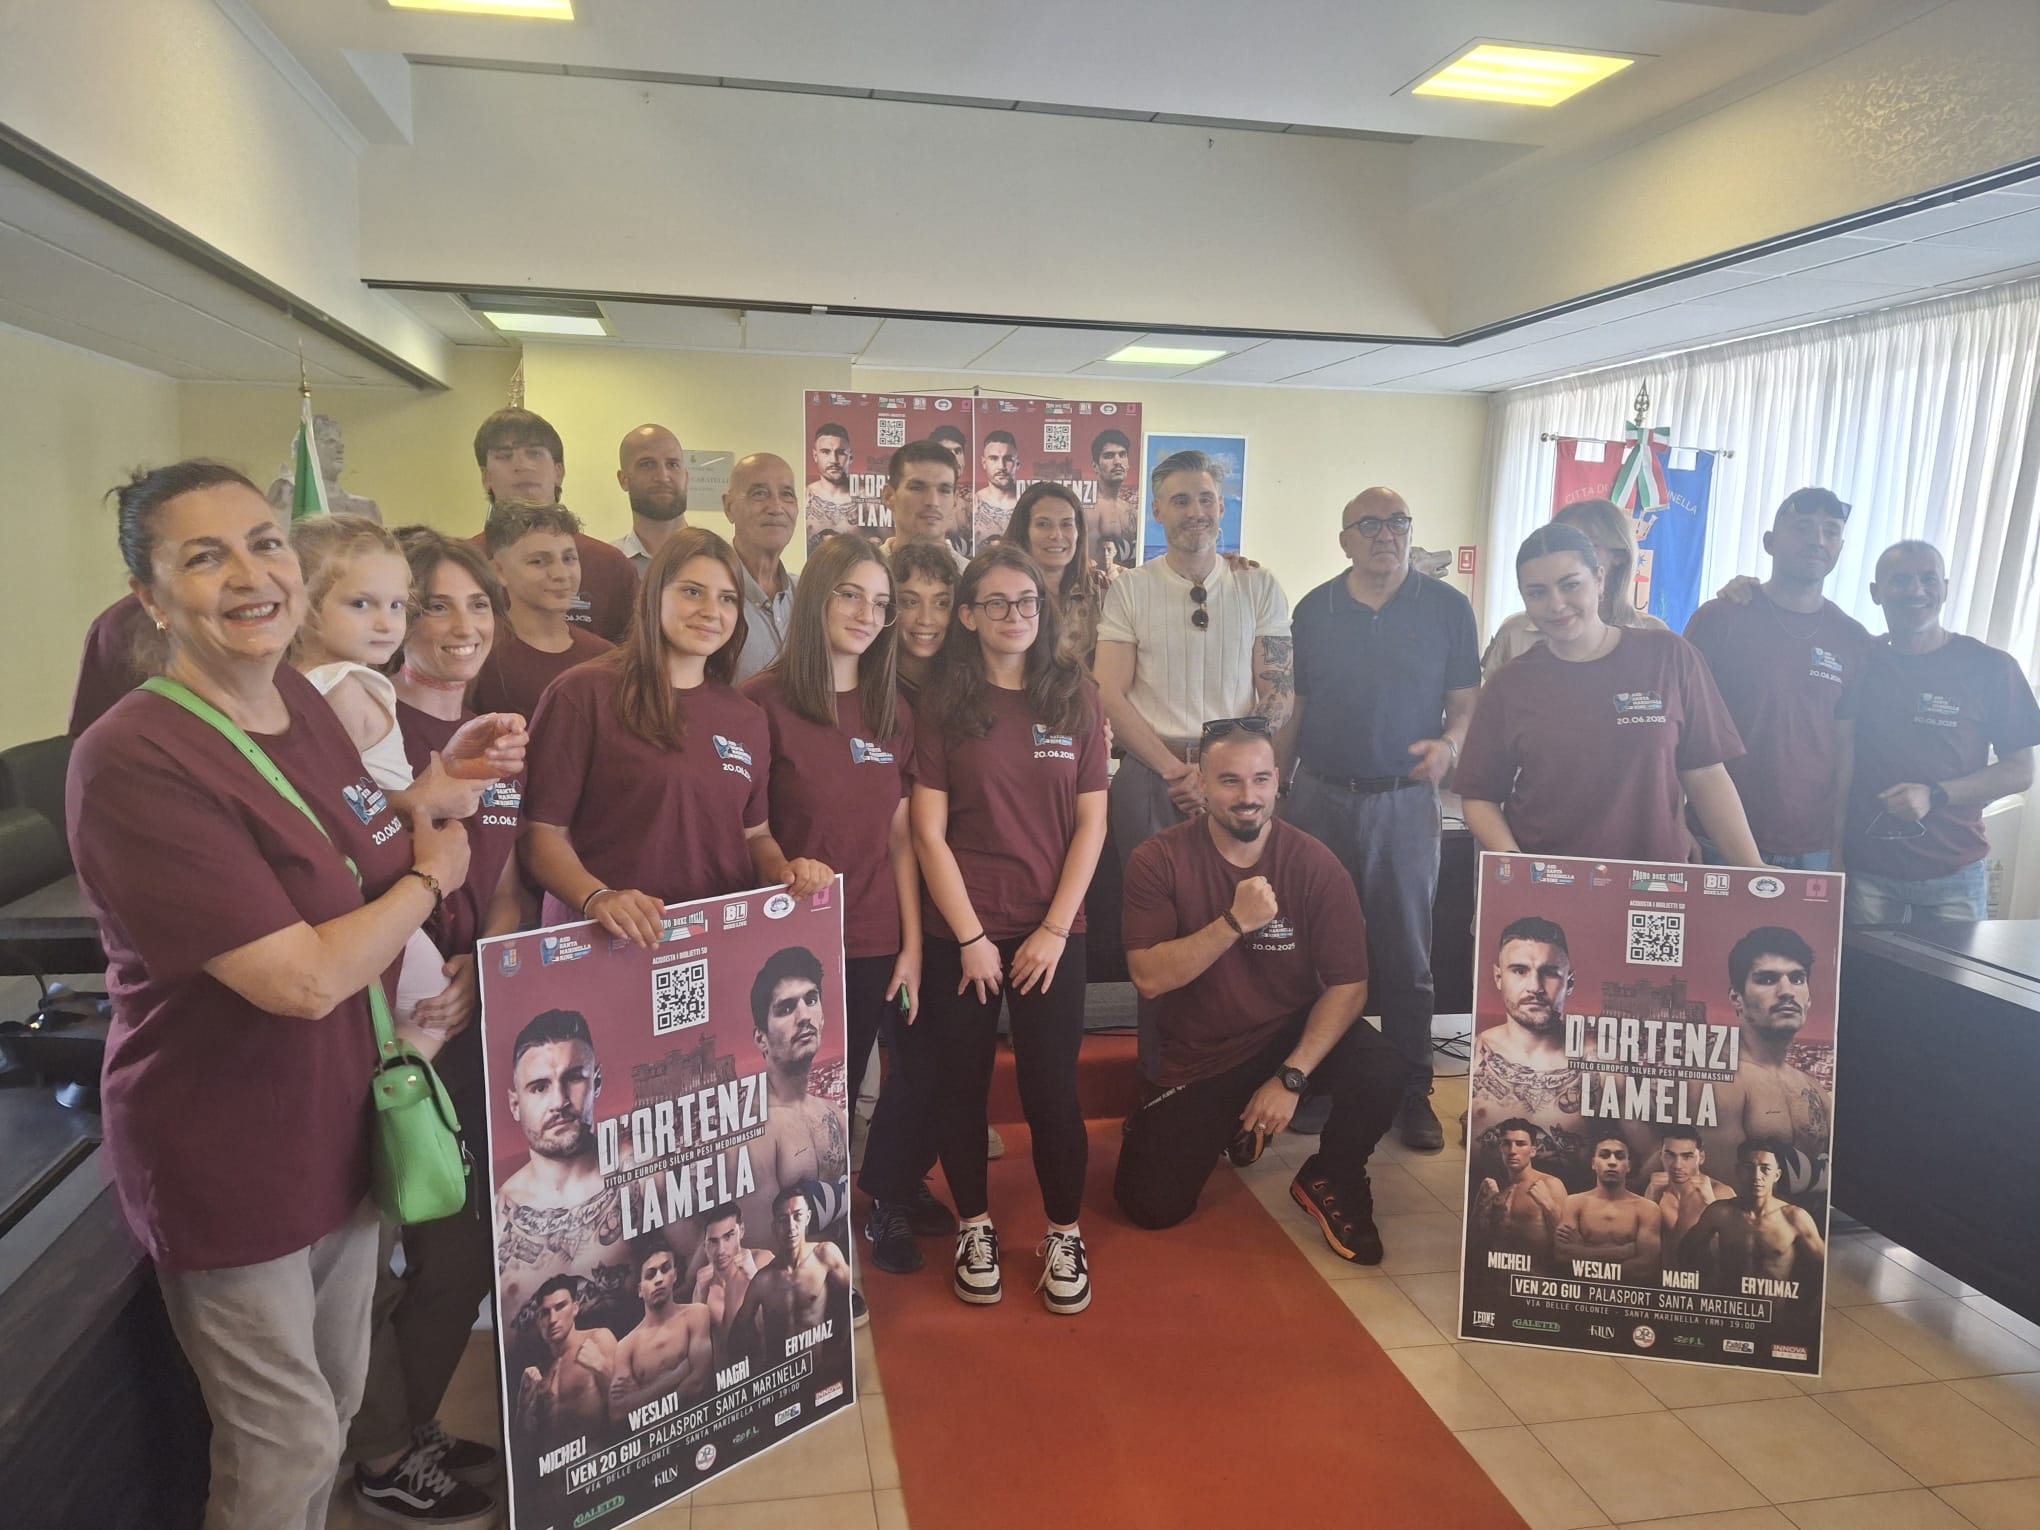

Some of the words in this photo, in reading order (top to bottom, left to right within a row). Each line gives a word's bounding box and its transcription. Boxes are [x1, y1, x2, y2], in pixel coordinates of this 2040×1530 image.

[1616, 715, 1666, 725] 20.06.2025
[725, 902, 747, 922] BL
[1564, 1013, 1740, 1072] D'ORTENZI
[1569, 1061, 1595, 1072] TITOLO
[1596, 1063, 1630, 1074] EUROPEO
[1631, 1066, 1657, 1076] SILVER
[1659, 1068, 1676, 1078] PESI
[1678, 1070, 1735, 1082] MEDIOMASSIMI
[1580, 1072, 1718, 1128] LAMELA
[597, 1071, 769, 1177] D'ORTENZI
[605, 1172, 633, 1189] TITOLO
[634, 1159, 668, 1180] EUROPEO
[669, 1150, 695, 1167] SILVER
[696, 1144, 714, 1158] PESI
[715, 1126, 766, 1153] MEDIOMASSIMI
[620, 1144, 756, 1242] LAMELA
[1487, 1251, 1531, 1273] MICHELI
[1572, 1259, 1622, 1282] WESLATI
[1515, 1278, 1539, 1296] VEN
[1541, 1281, 1558, 1298] 20
[1561, 1283, 1582, 1300] GIU
[1588, 1286, 1652, 1307] PALASPORT
[1658, 1293, 1695, 1312] SANTA
[1699, 1298, 1765, 1319] MARINELLA
[1741, 1276, 1800, 1300] ERYILMAZ
[1473, 1310, 1496, 1327] LEONE
[1525, 1299, 1542, 1308] VIA
[1545, 1301, 1571, 1312] DELLE
[1574, 1303, 1609, 1316] COLONIE
[1624, 1308, 1650, 1320] SANTA
[1654, 1311, 1700, 1325] MARINELLA
[1704, 1317, 1725, 1328] (RM)
[1729, 1320, 1756, 1331] 19:00
[785, 1318, 834, 1358] ERYILMAZ
[1772, 1344, 1808, 1355] INNOVA
[815, 1381, 843, 1400] INNOVA
[570, 1459, 598, 1488] VEN
[600, 1450, 618, 1475] 20
[620, 1438, 642, 1464] GIU
[649, 1405, 710, 1449] PALASPORT
[715, 1387, 748, 1417] SANTA
[752, 1358, 808, 1399] MARINELLA
[628, 1390, 679, 1432] WESLATI
[538, 1434, 587, 1478] MICHELI
[585, 1480, 601, 1496] VIA
[606, 1465, 631, 1486] DELLE
[636, 1446, 671, 1470] COLONIE
[685, 1428, 710, 1447] SANTA
[713, 1404, 755, 1433] MARINELLA
[758, 1395, 775, 1410] (RM)
[779, 1381, 801, 1400] 19:00
